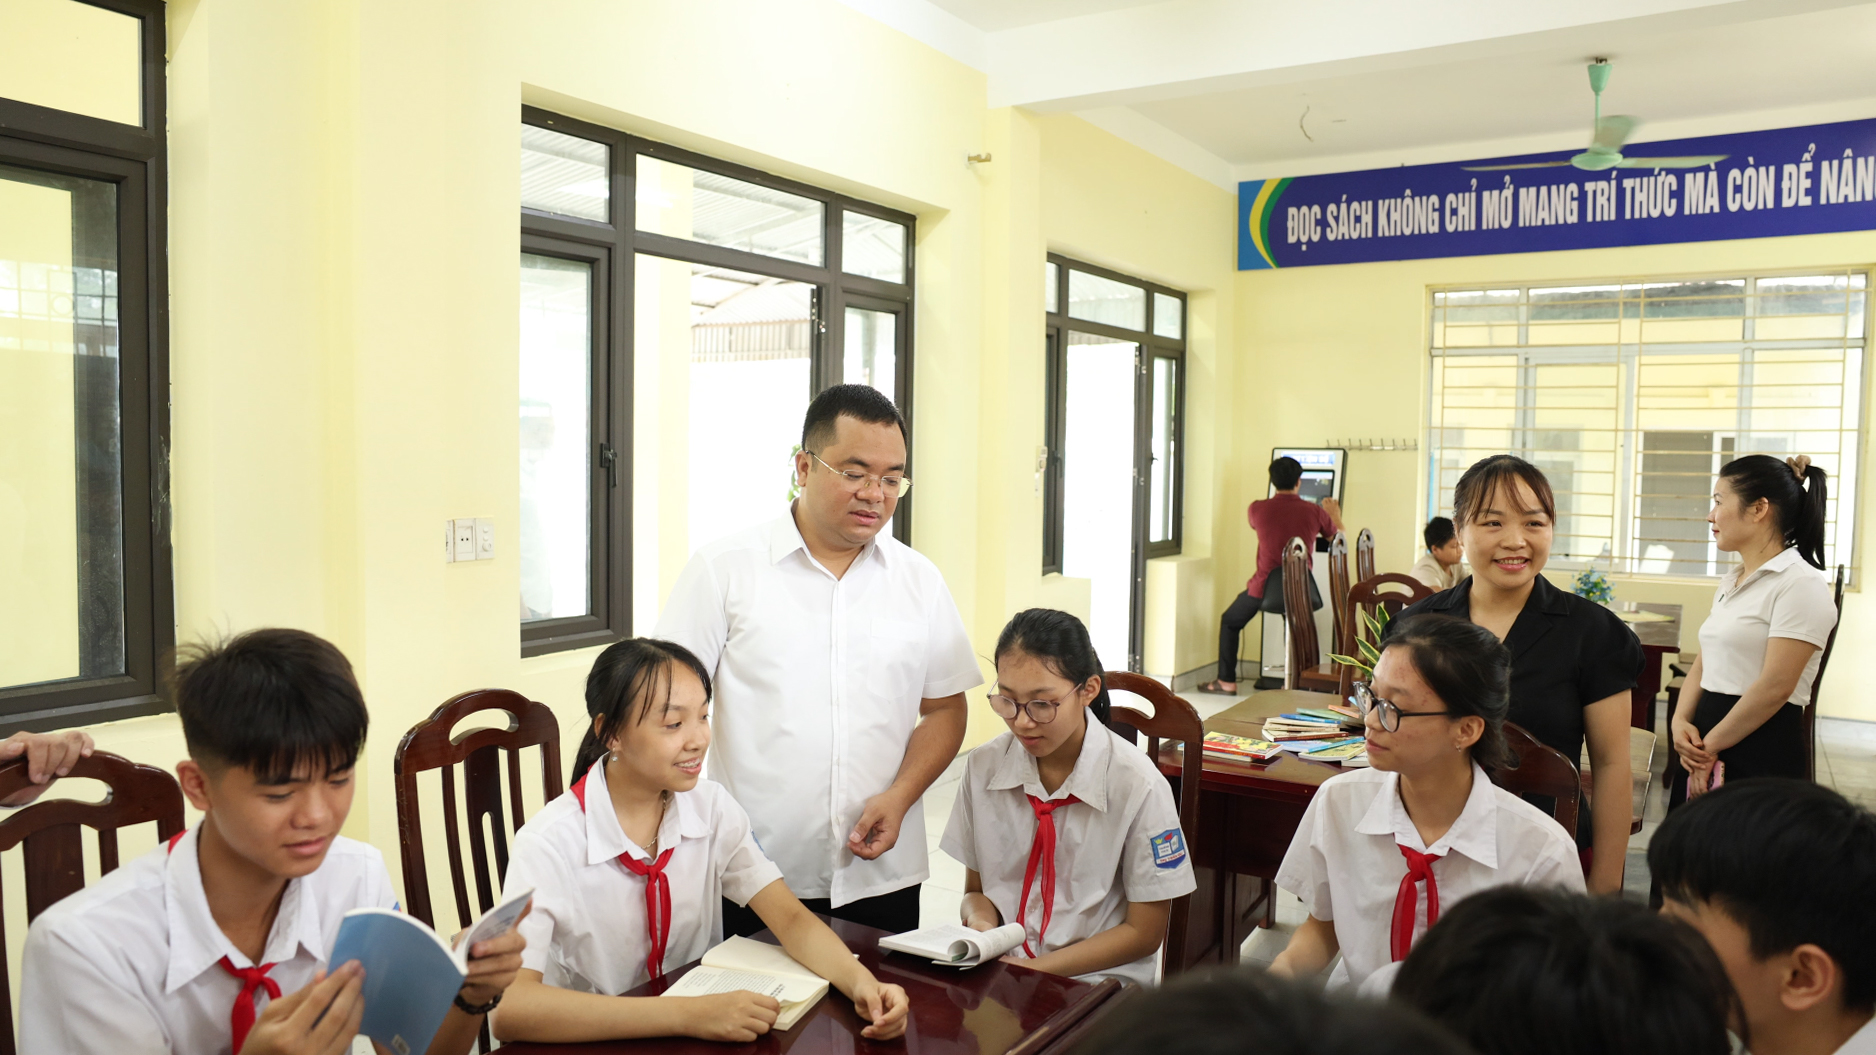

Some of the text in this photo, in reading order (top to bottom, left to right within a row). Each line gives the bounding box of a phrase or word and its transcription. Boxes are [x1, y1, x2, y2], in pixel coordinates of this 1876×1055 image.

[1286, 142, 1876, 252] ĐỌC SÁCH KHÔNG CHỈ MỞ MANG TRÍ THỨC MÀ CÒN ĐỂ NÂN
